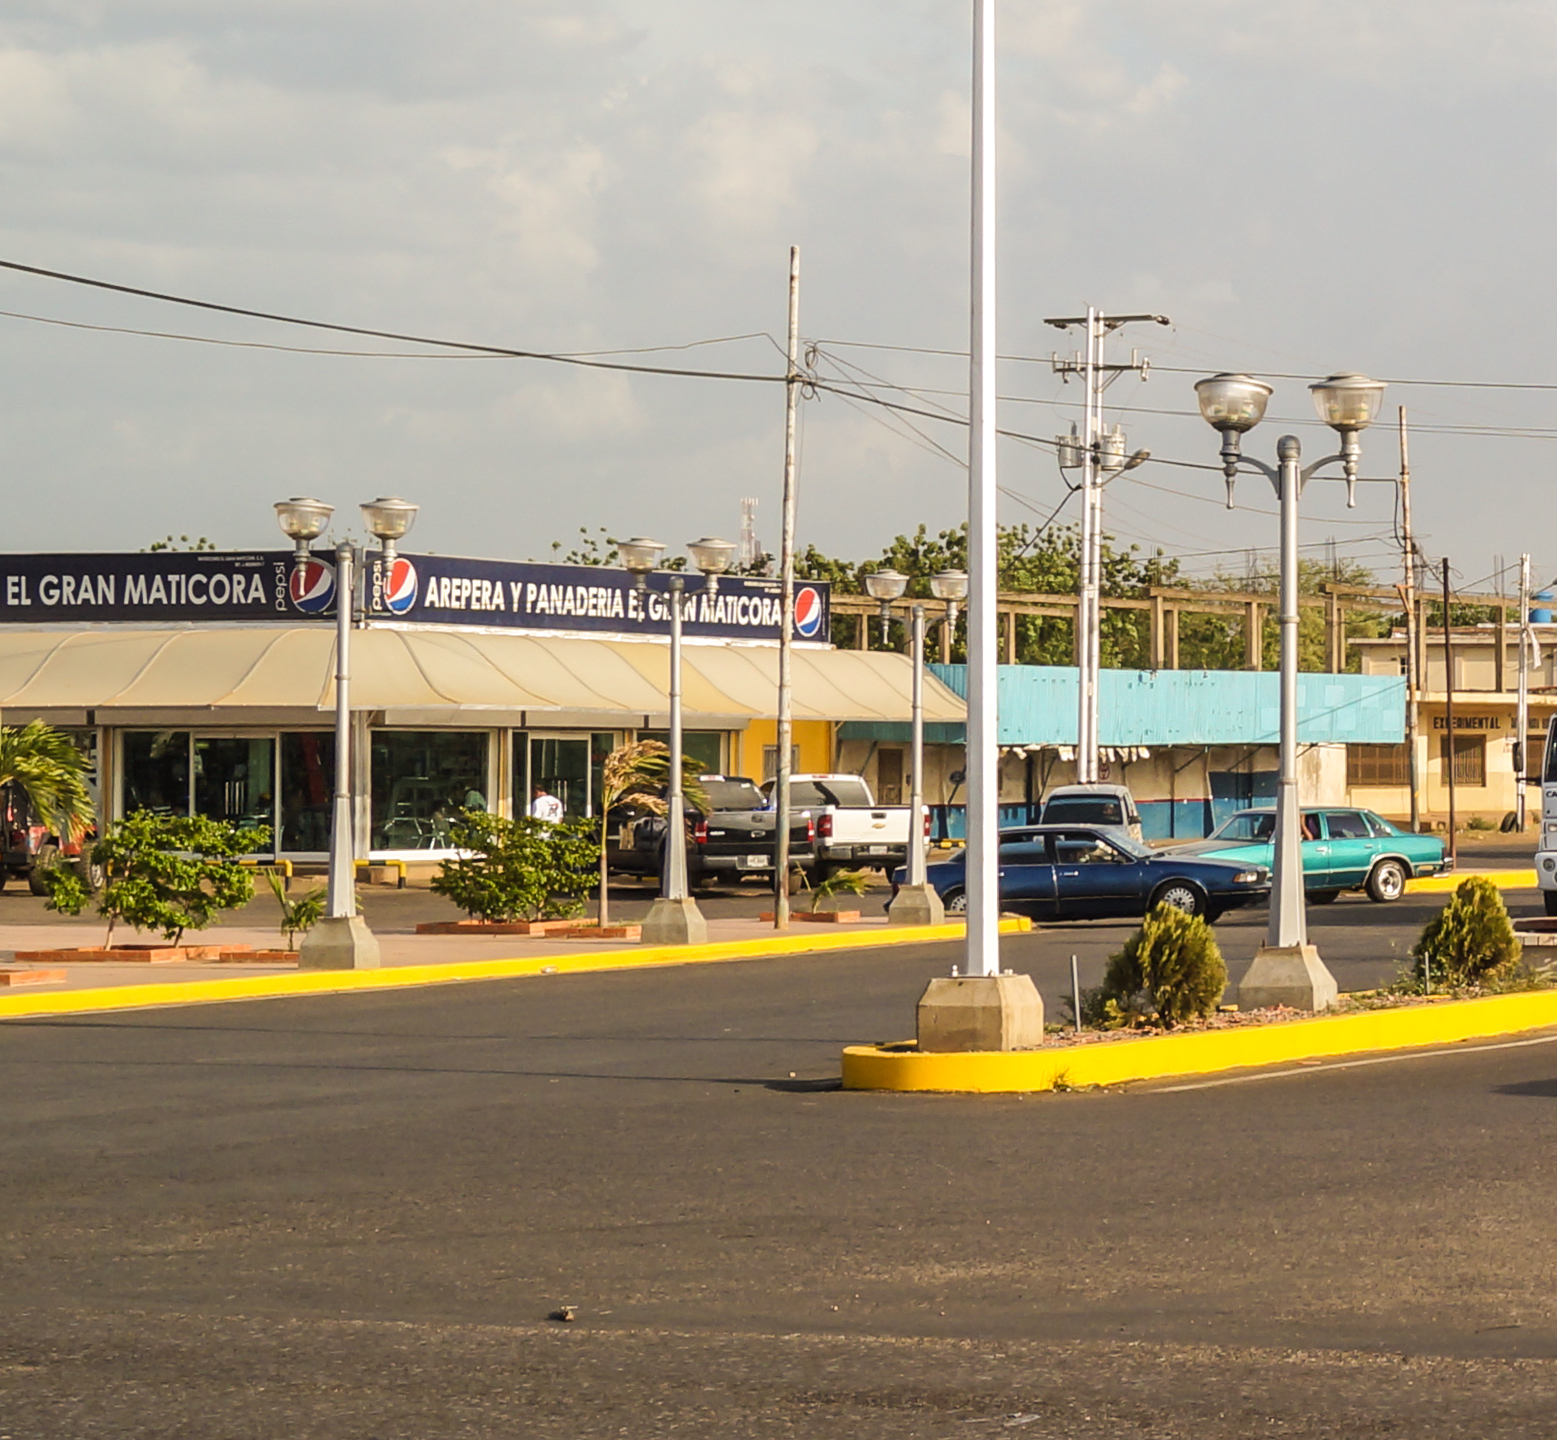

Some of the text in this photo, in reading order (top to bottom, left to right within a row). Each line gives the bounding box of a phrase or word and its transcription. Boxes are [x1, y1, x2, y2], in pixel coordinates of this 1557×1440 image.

[6, 573, 267, 606] EL GRAN MATICORA
[274, 561, 287, 611] pepsi
[372, 560, 383, 611] pepsi
[424, 576, 505, 611] AREPERA
[509, 581, 523, 613] Y
[526, 583, 624, 618] PANADERIA
